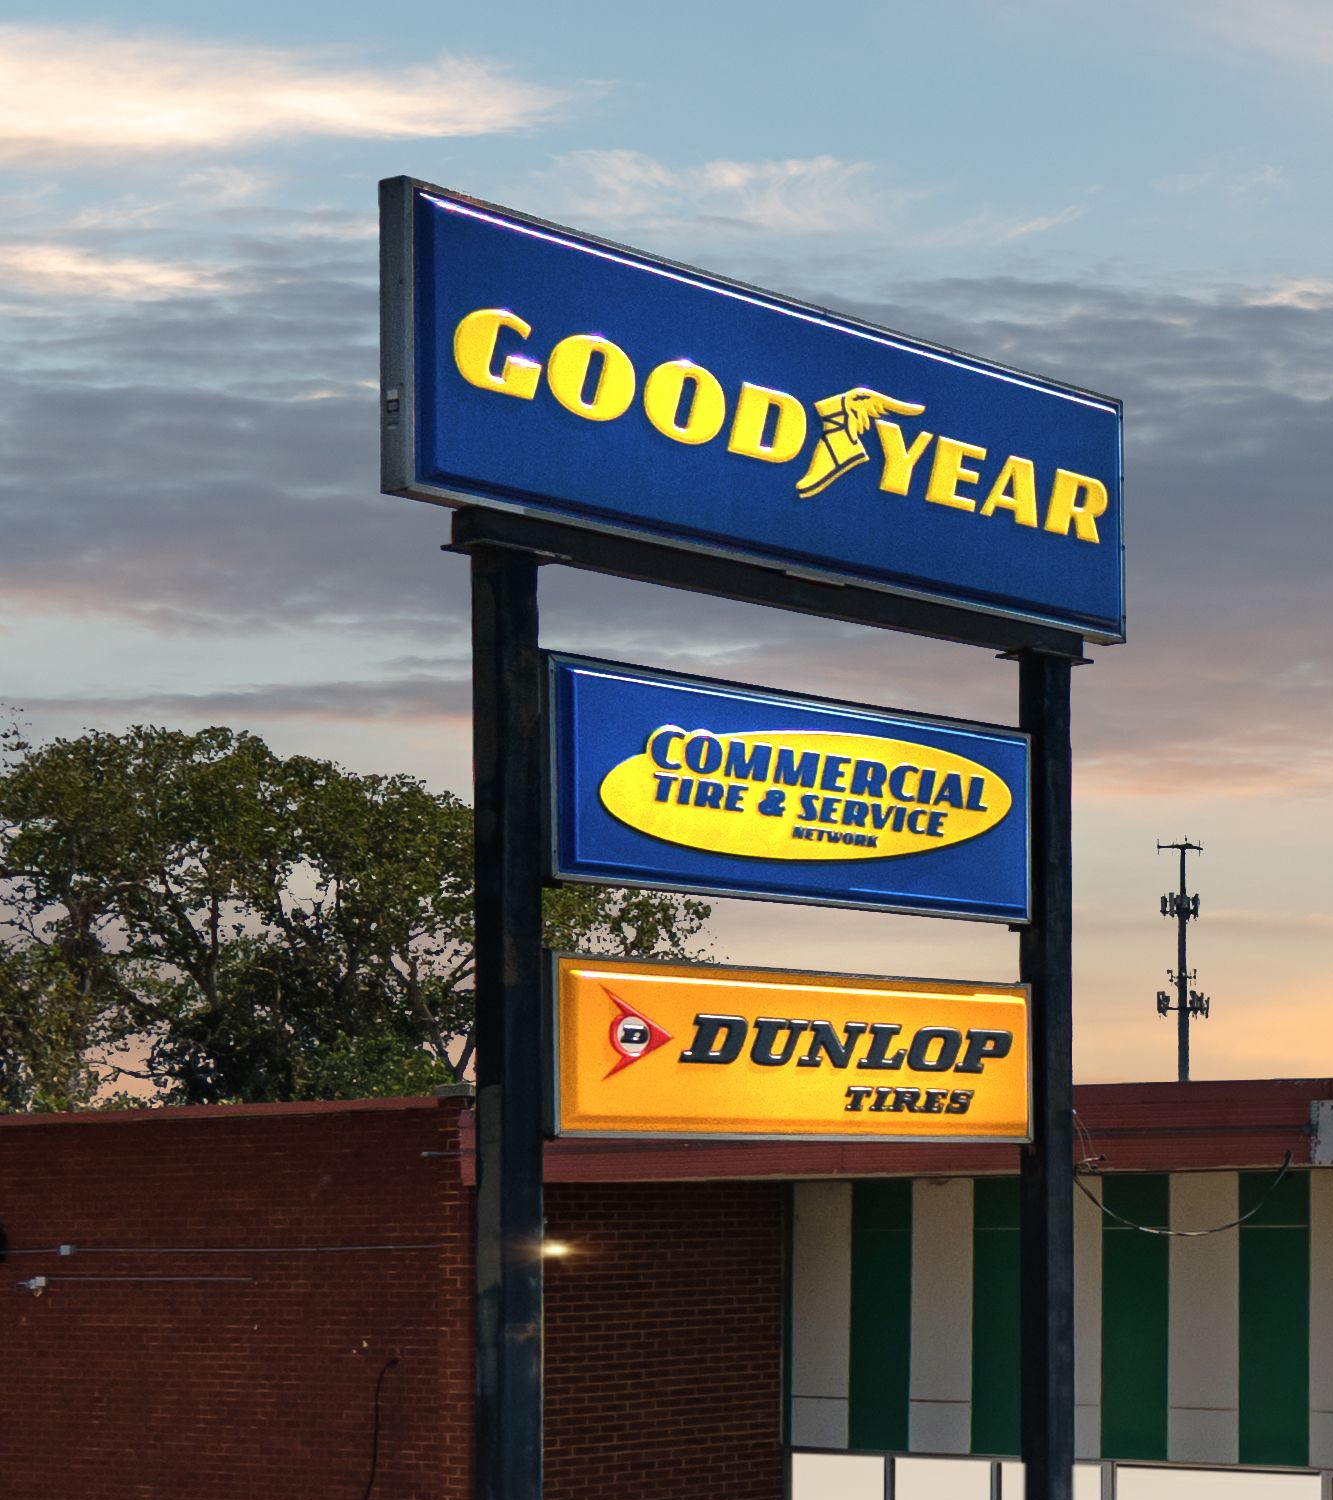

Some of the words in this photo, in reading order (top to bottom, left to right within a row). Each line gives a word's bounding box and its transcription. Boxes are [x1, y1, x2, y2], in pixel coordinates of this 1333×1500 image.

[648, 730, 988, 813] COMMERCIAL
[653, 772, 745, 813] TIRE
[758, 789, 788, 818] &
[797, 792, 949, 838] SERVICE
[791, 825, 880, 849] NETWORK
[678, 1013, 1014, 1074] DUNLOP
[844, 1085, 975, 1115] TIRES
